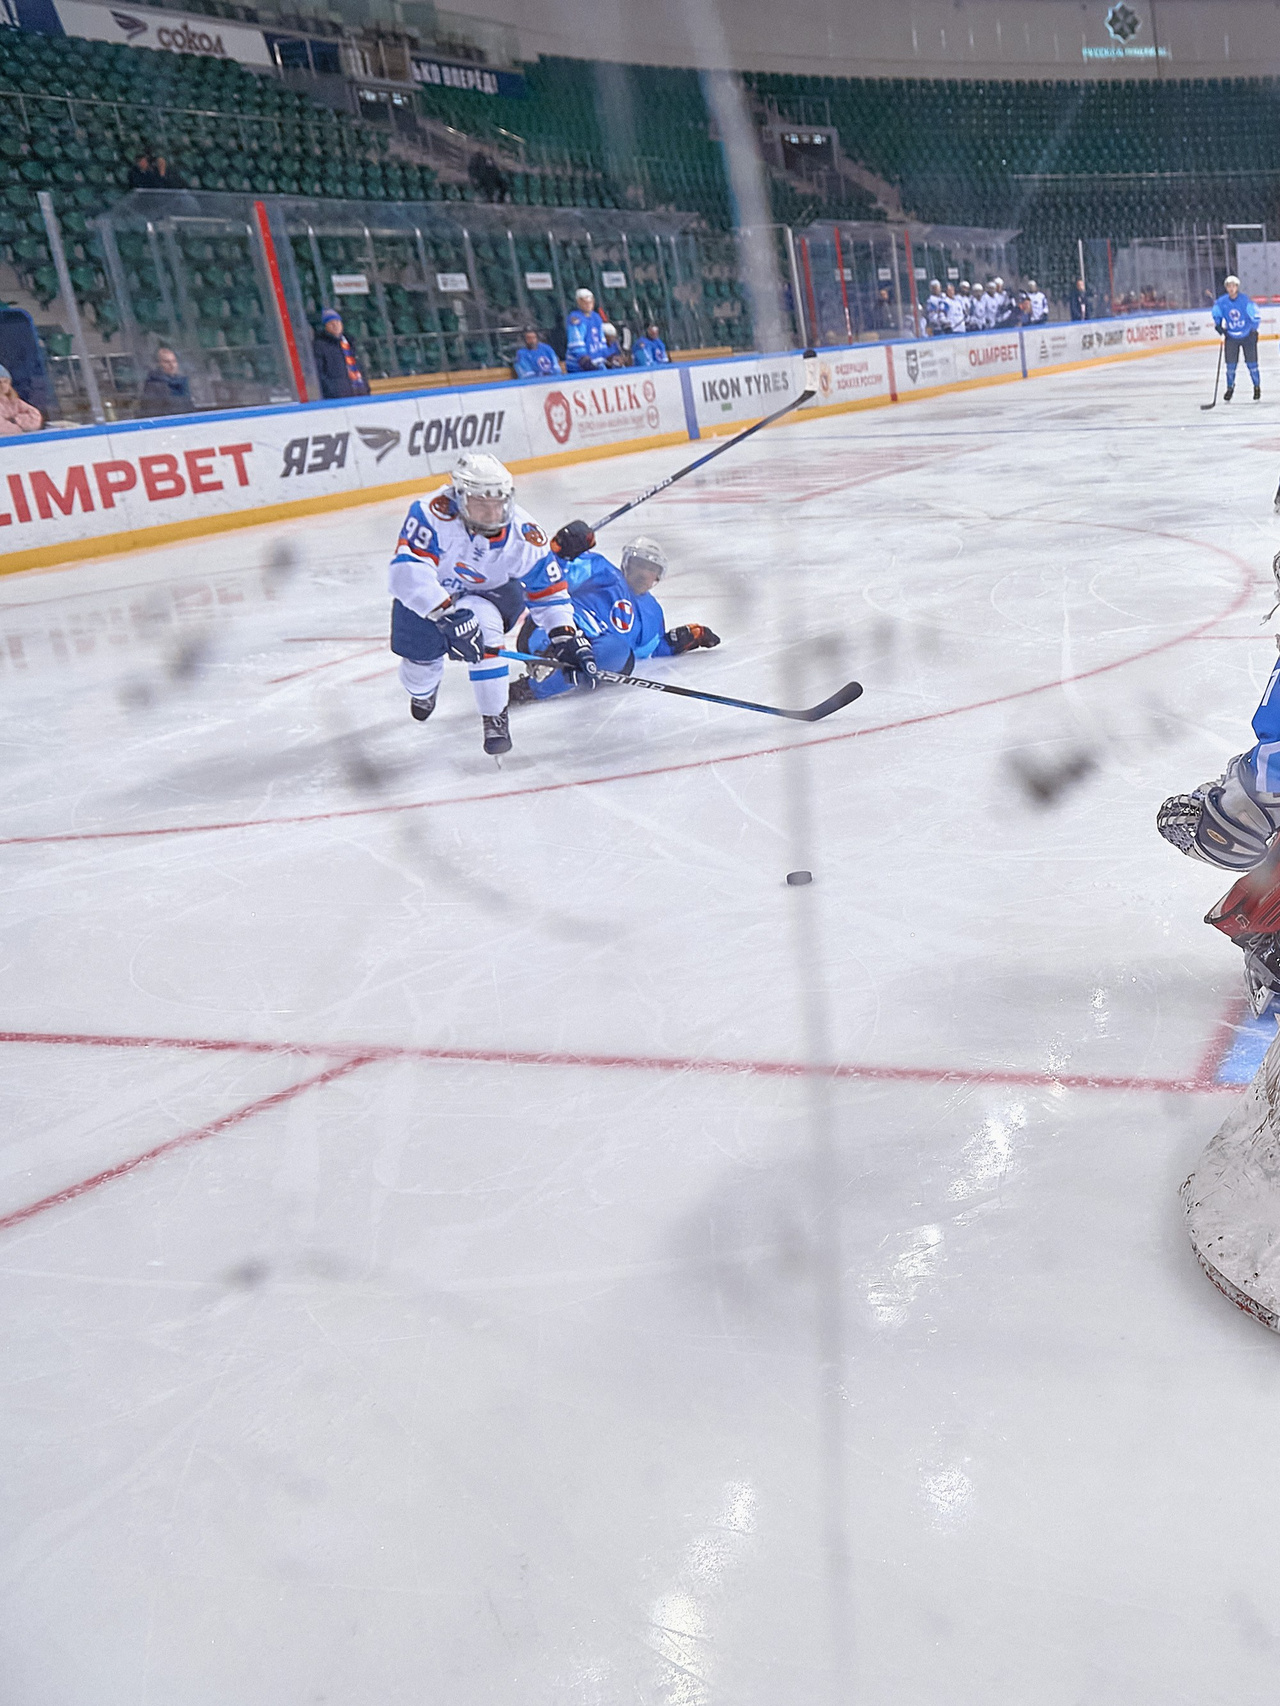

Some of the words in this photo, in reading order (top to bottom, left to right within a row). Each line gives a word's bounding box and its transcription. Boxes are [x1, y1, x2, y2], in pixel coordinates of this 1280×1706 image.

[969, 344, 1018, 367] OLIMPBET
[573, 383, 642, 416] SALEK
[702, 377, 742, 403] IKON
[744, 371, 789, 396] TYRES
[408, 410, 505, 456] СОКОЛ!
[405, 516, 433, 550] 99
